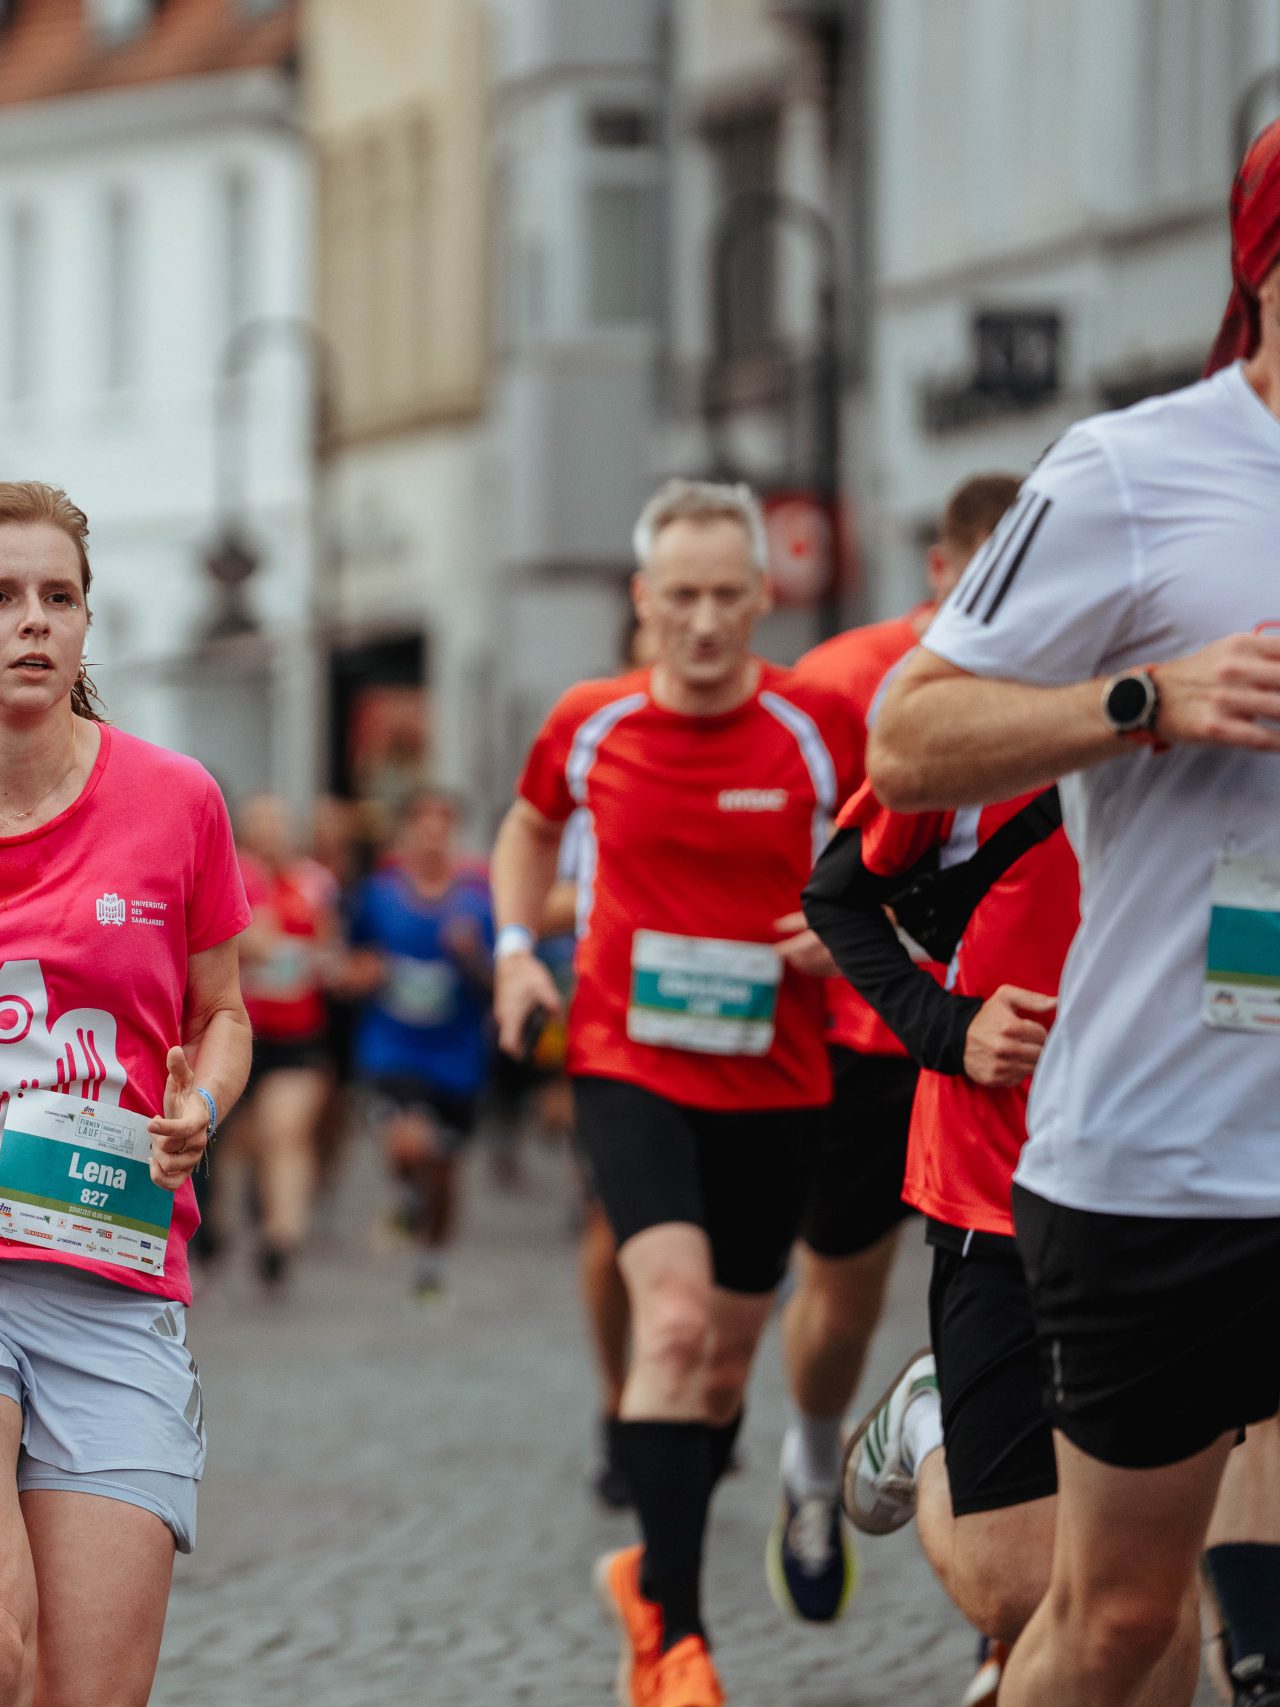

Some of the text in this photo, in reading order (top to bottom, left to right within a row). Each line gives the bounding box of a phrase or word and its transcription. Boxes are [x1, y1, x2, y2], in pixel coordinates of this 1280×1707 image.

[131, 900, 167, 910] UNIVERSITÄT
[131, 917, 165, 927] SAARLANDES
[83, 1105, 95, 1114] dm
[80, 1118, 100, 1128] FIRMEN
[77, 1125, 100, 1138] LAUF
[68, 1151, 127, 1190] Lena
[80, 1188, 109, 1207] 827
